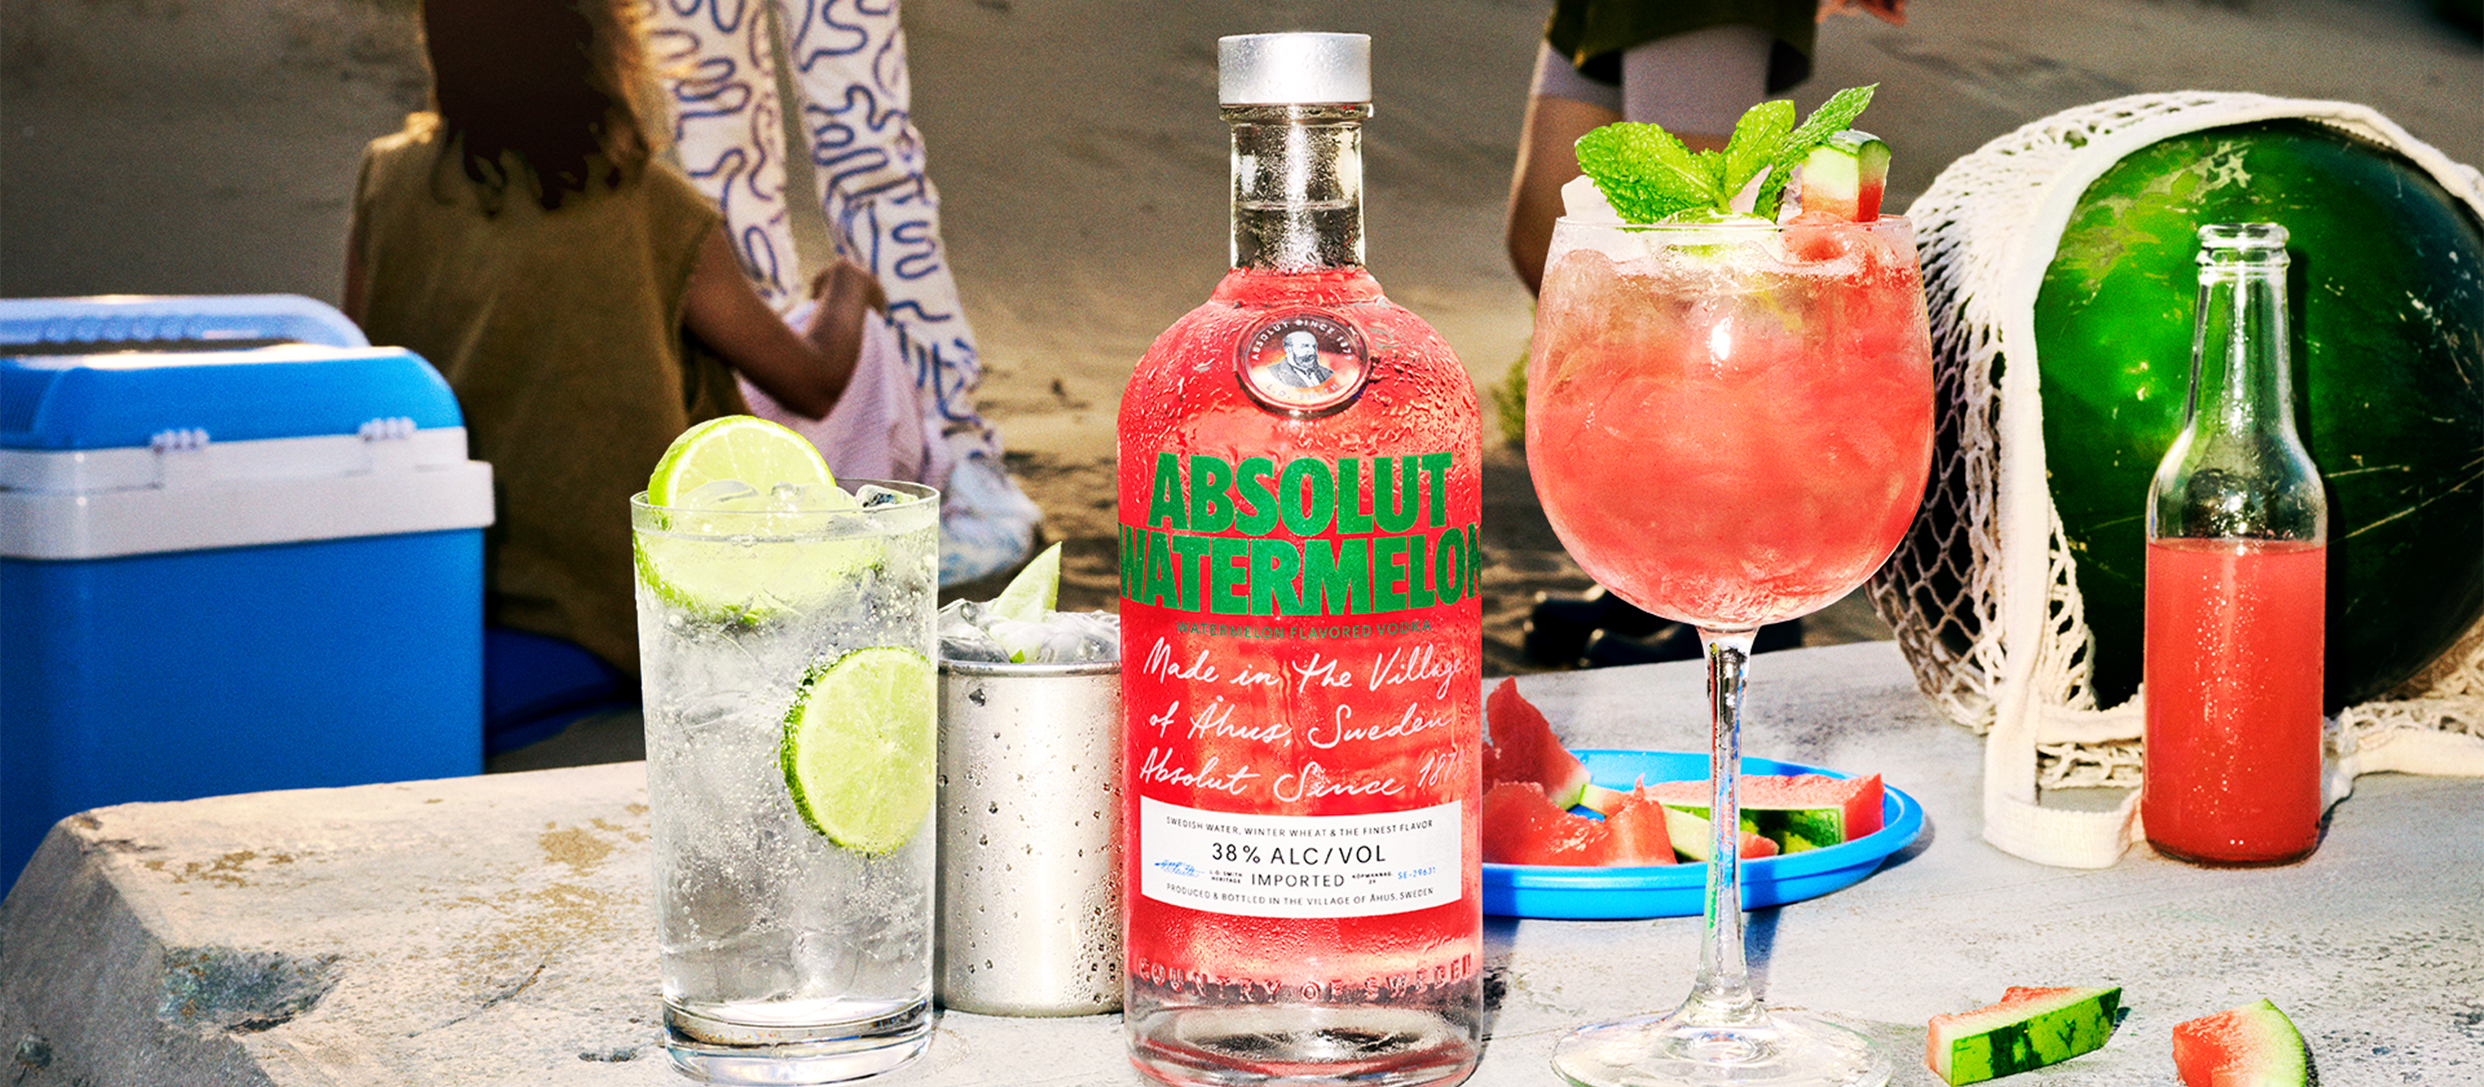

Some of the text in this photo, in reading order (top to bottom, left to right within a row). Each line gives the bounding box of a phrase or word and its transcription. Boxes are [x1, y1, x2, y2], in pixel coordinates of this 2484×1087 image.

[1251, 320, 1290, 360] ABSOLUT
[1299, 383, 1340, 401] SMITH
[1147, 451, 1452, 537] ABSOLUT
[1118, 522, 1482, 616] WATERMELON
[1176, 620, 1432, 640] WATERMELON FLAVORED VODKA
[1143, 636, 1463, 700] Made in the Village
[1149, 700, 1175, 739] of
[1307, 703, 1453, 750] Sweden
[1139, 746, 1261, 795] Absolut
[1273, 760, 1407, 803] Since
[1166, 816, 1203, 830] SWEDISH
[1244, 827, 1286, 837] WINTER
[1289, 827, 1327, 838] WHEAT
[1329, 829, 1337, 837] &
[1340, 827, 1359, 837] THE
[1362, 824, 1397, 835] FINEST
[1399, 819, 1434, 832] FLAVOR
[1212, 842, 1261, 864] 38%
[1166, 883, 1211, 899] PRODUCED
[1213, 892, 1219, 900] &
[1221, 893, 1266, 905] BOTTLED
[1269, 897, 1280, 905] IN
[1284, 897, 1304, 906] THE
[1307, 896, 1350, 906] VILLAGE
[1353, 895, 1367, 904] OF
[1399, 887, 1434, 900] SWEDEN
[1251, 873, 1345, 888] IMPORTED
[1138, 953, 1473, 1003] COUNTRY OF SWEDEN
